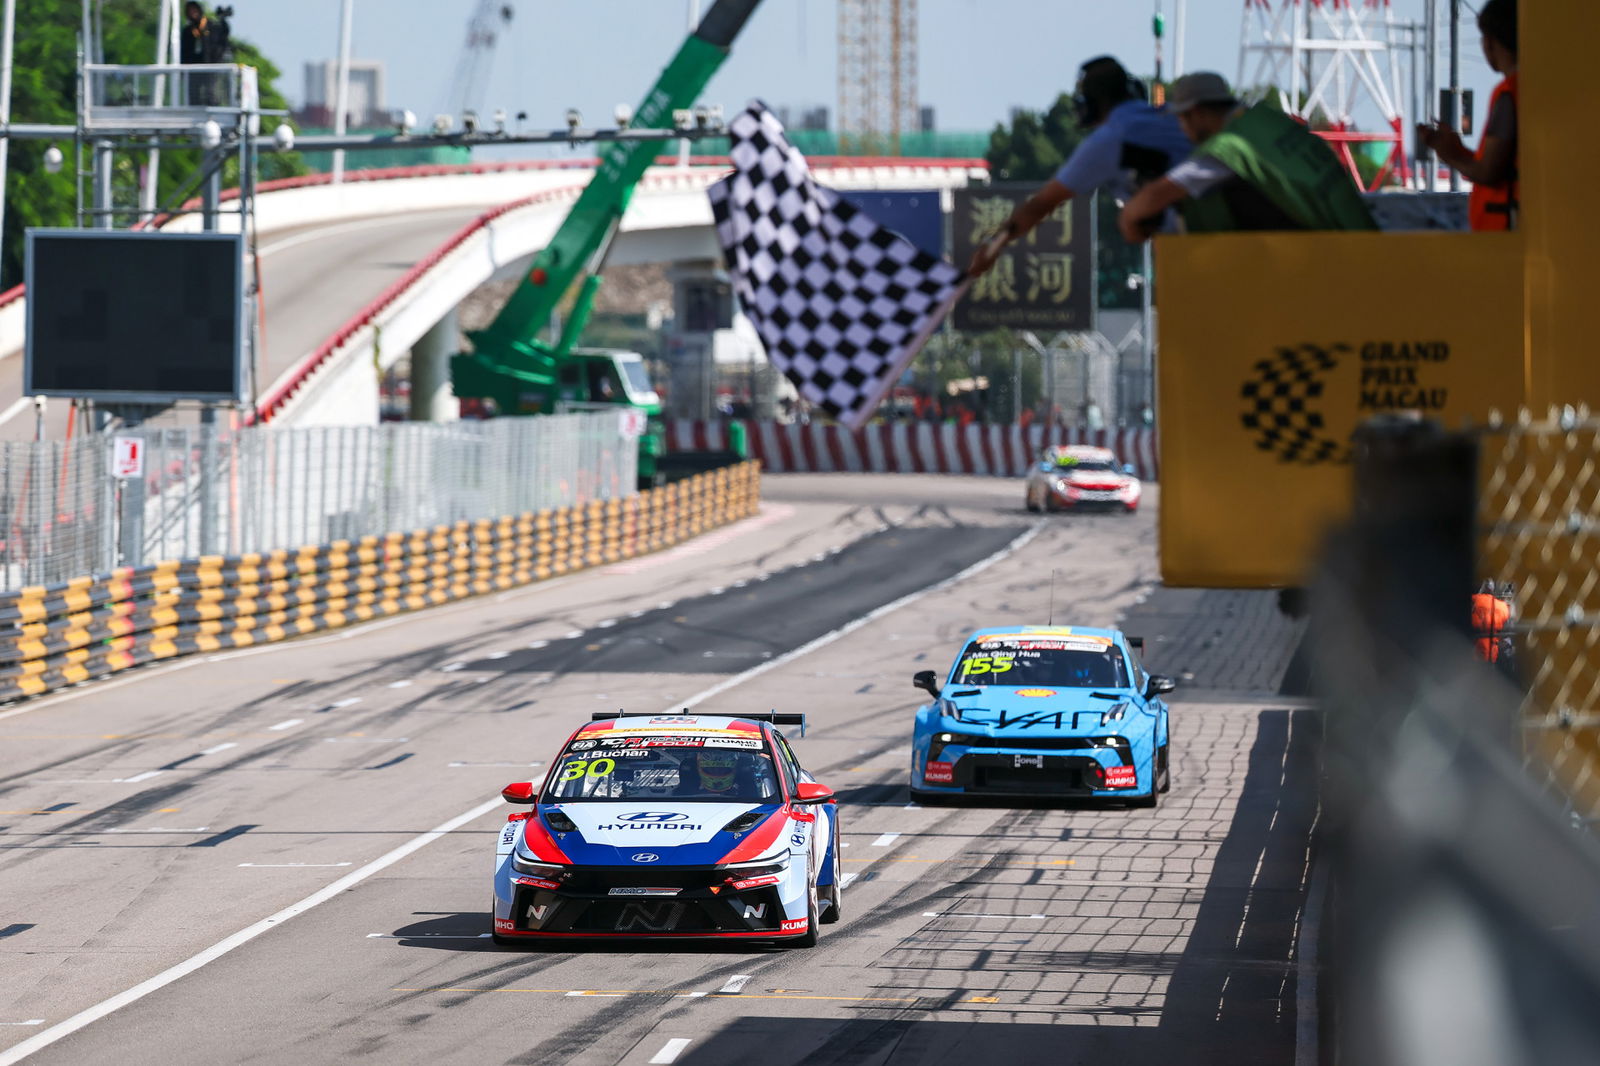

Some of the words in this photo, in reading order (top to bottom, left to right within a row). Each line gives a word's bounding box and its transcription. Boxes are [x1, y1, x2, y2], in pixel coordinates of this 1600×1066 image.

[1360, 342, 1449, 362] GRAND
[1360, 366, 1418, 386] PRIX
[1359, 389, 1448, 410] MACAU
[990, 651, 1017, 660] Qing
[1018, 650, 1041, 658] Hua
[962, 656, 1015, 676] 155
[578, 749, 649, 760] J.Buchan
[559, 757, 616, 781] 30
[1105, 776, 1135, 785] KUMHO
[495, 921, 514, 930] MHO
[781, 920, 808, 931] KUMH
